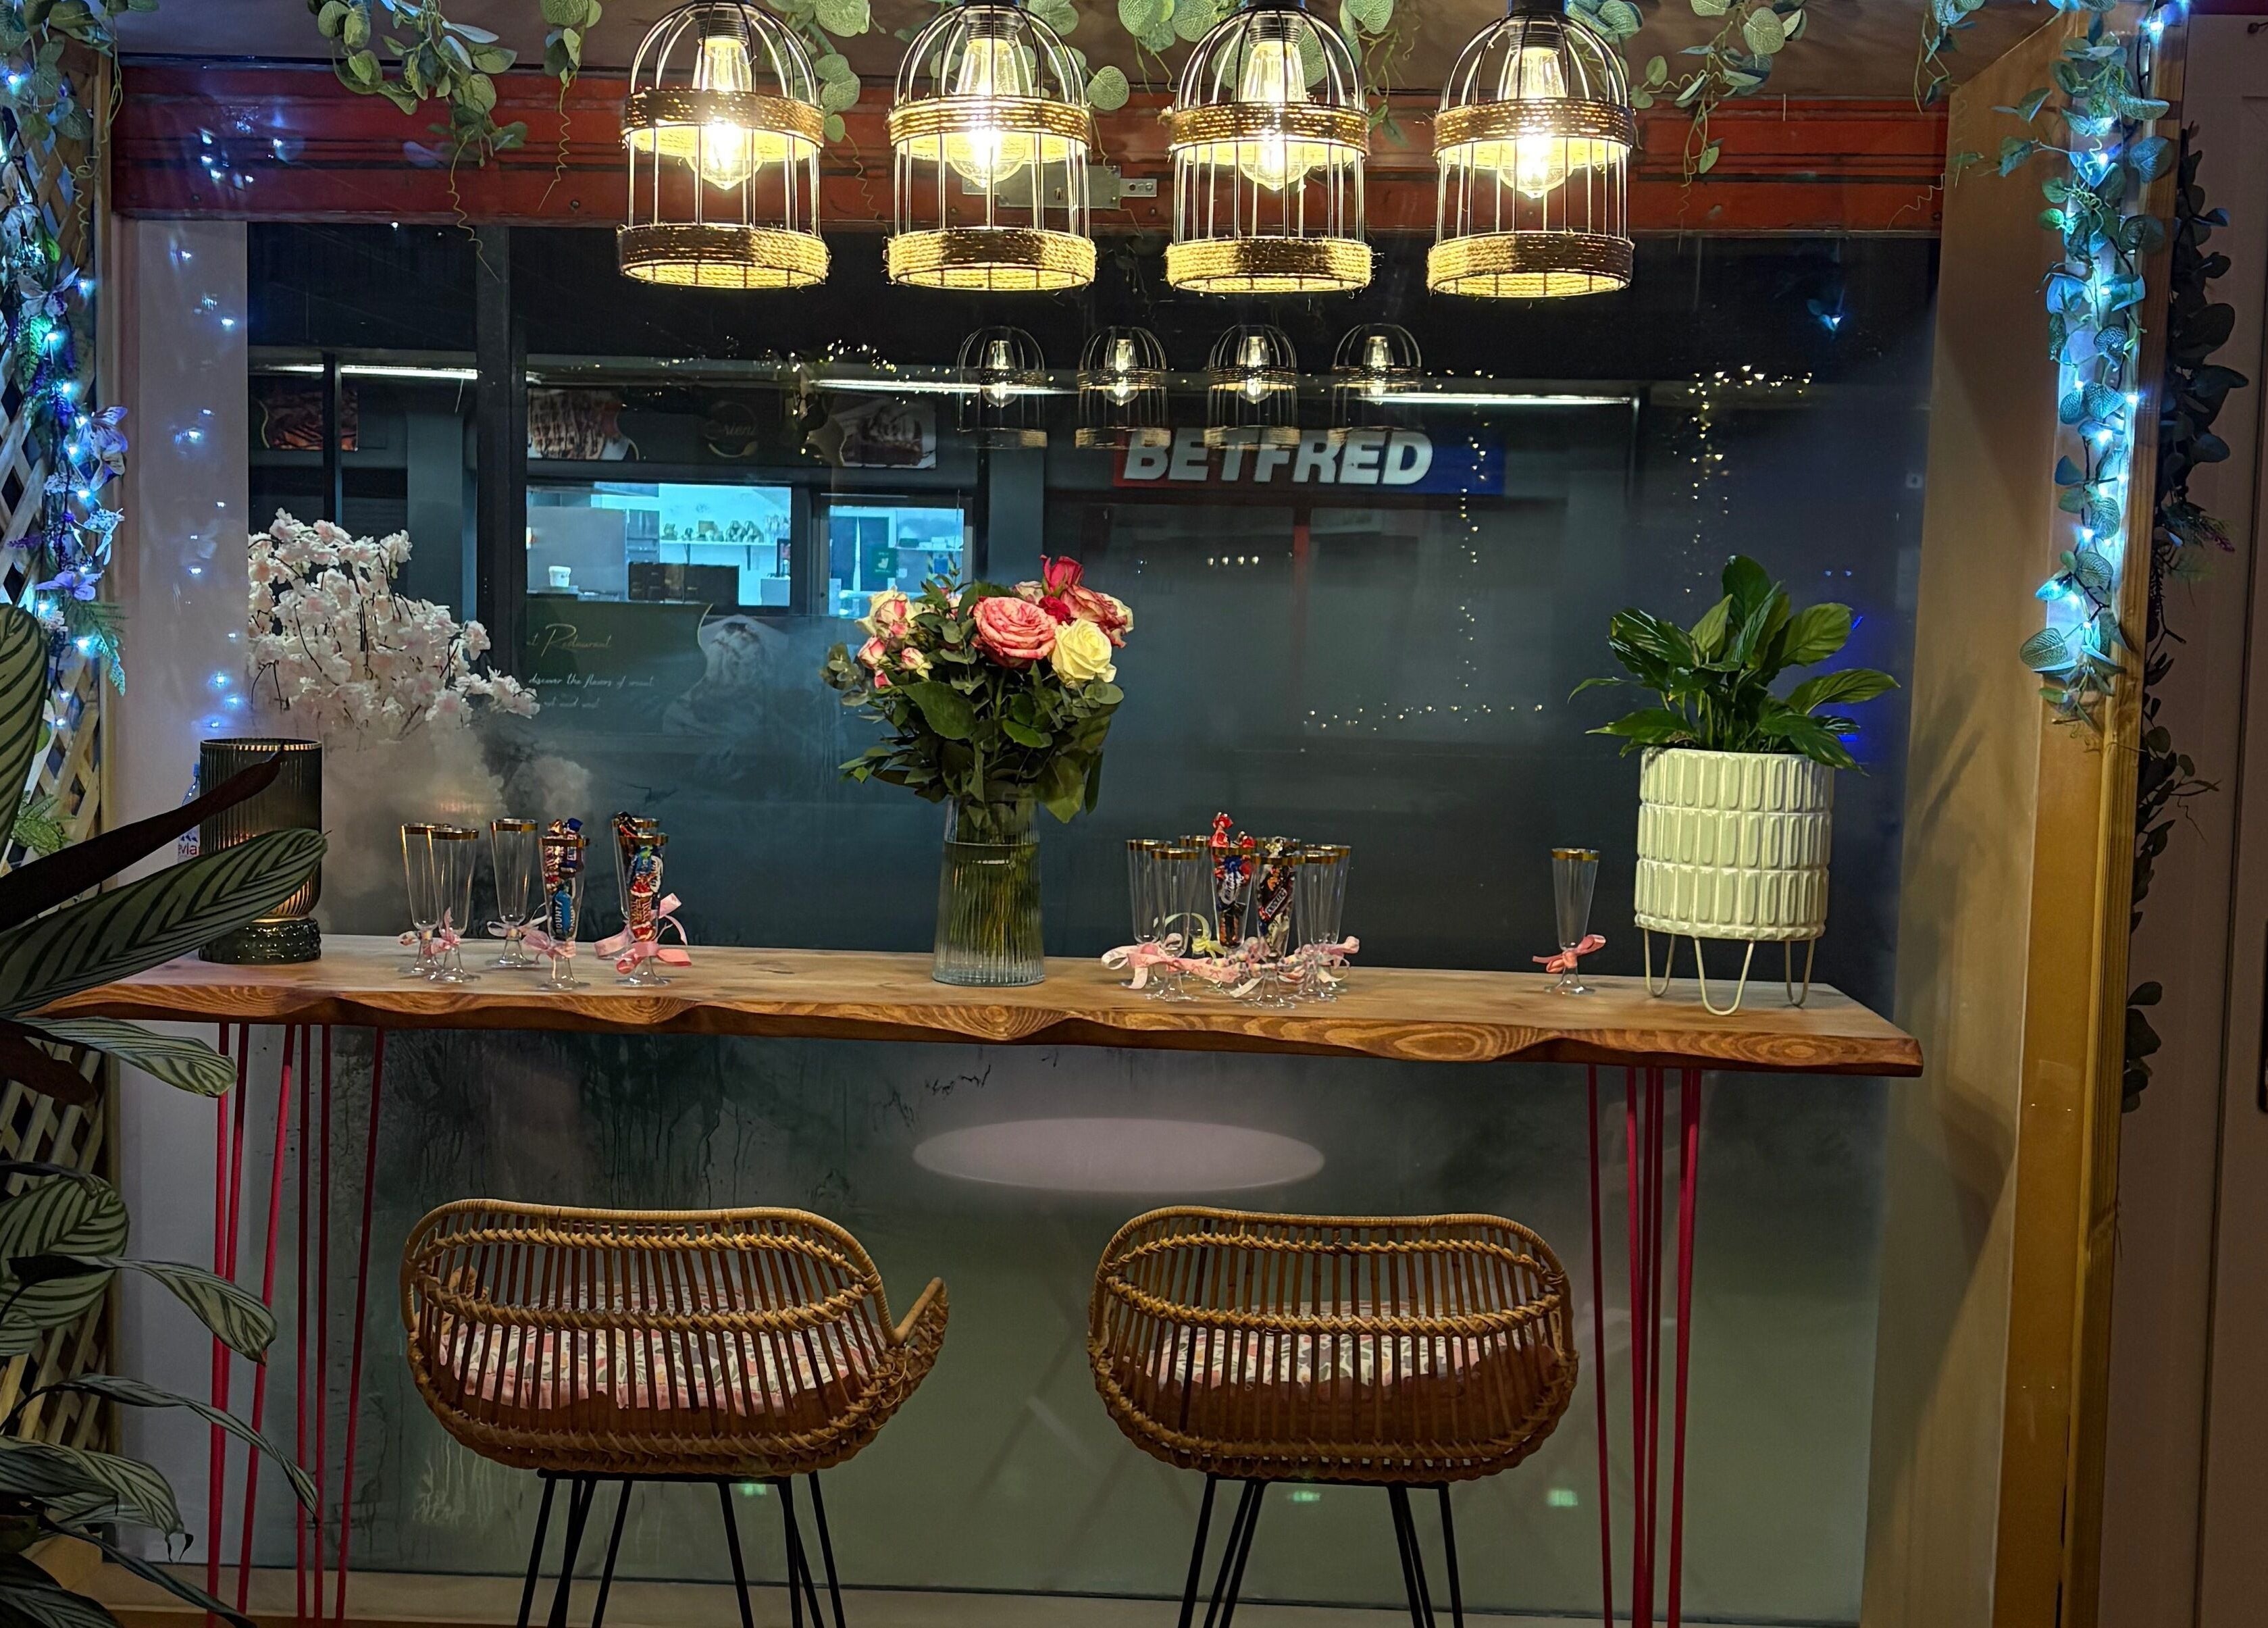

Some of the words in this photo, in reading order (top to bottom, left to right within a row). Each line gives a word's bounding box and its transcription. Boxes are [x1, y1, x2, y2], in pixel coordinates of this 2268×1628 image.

[1123, 427, 1433, 485] BETFRED
[567, 673, 582, 685] the
[178, 843, 197, 855] evia
